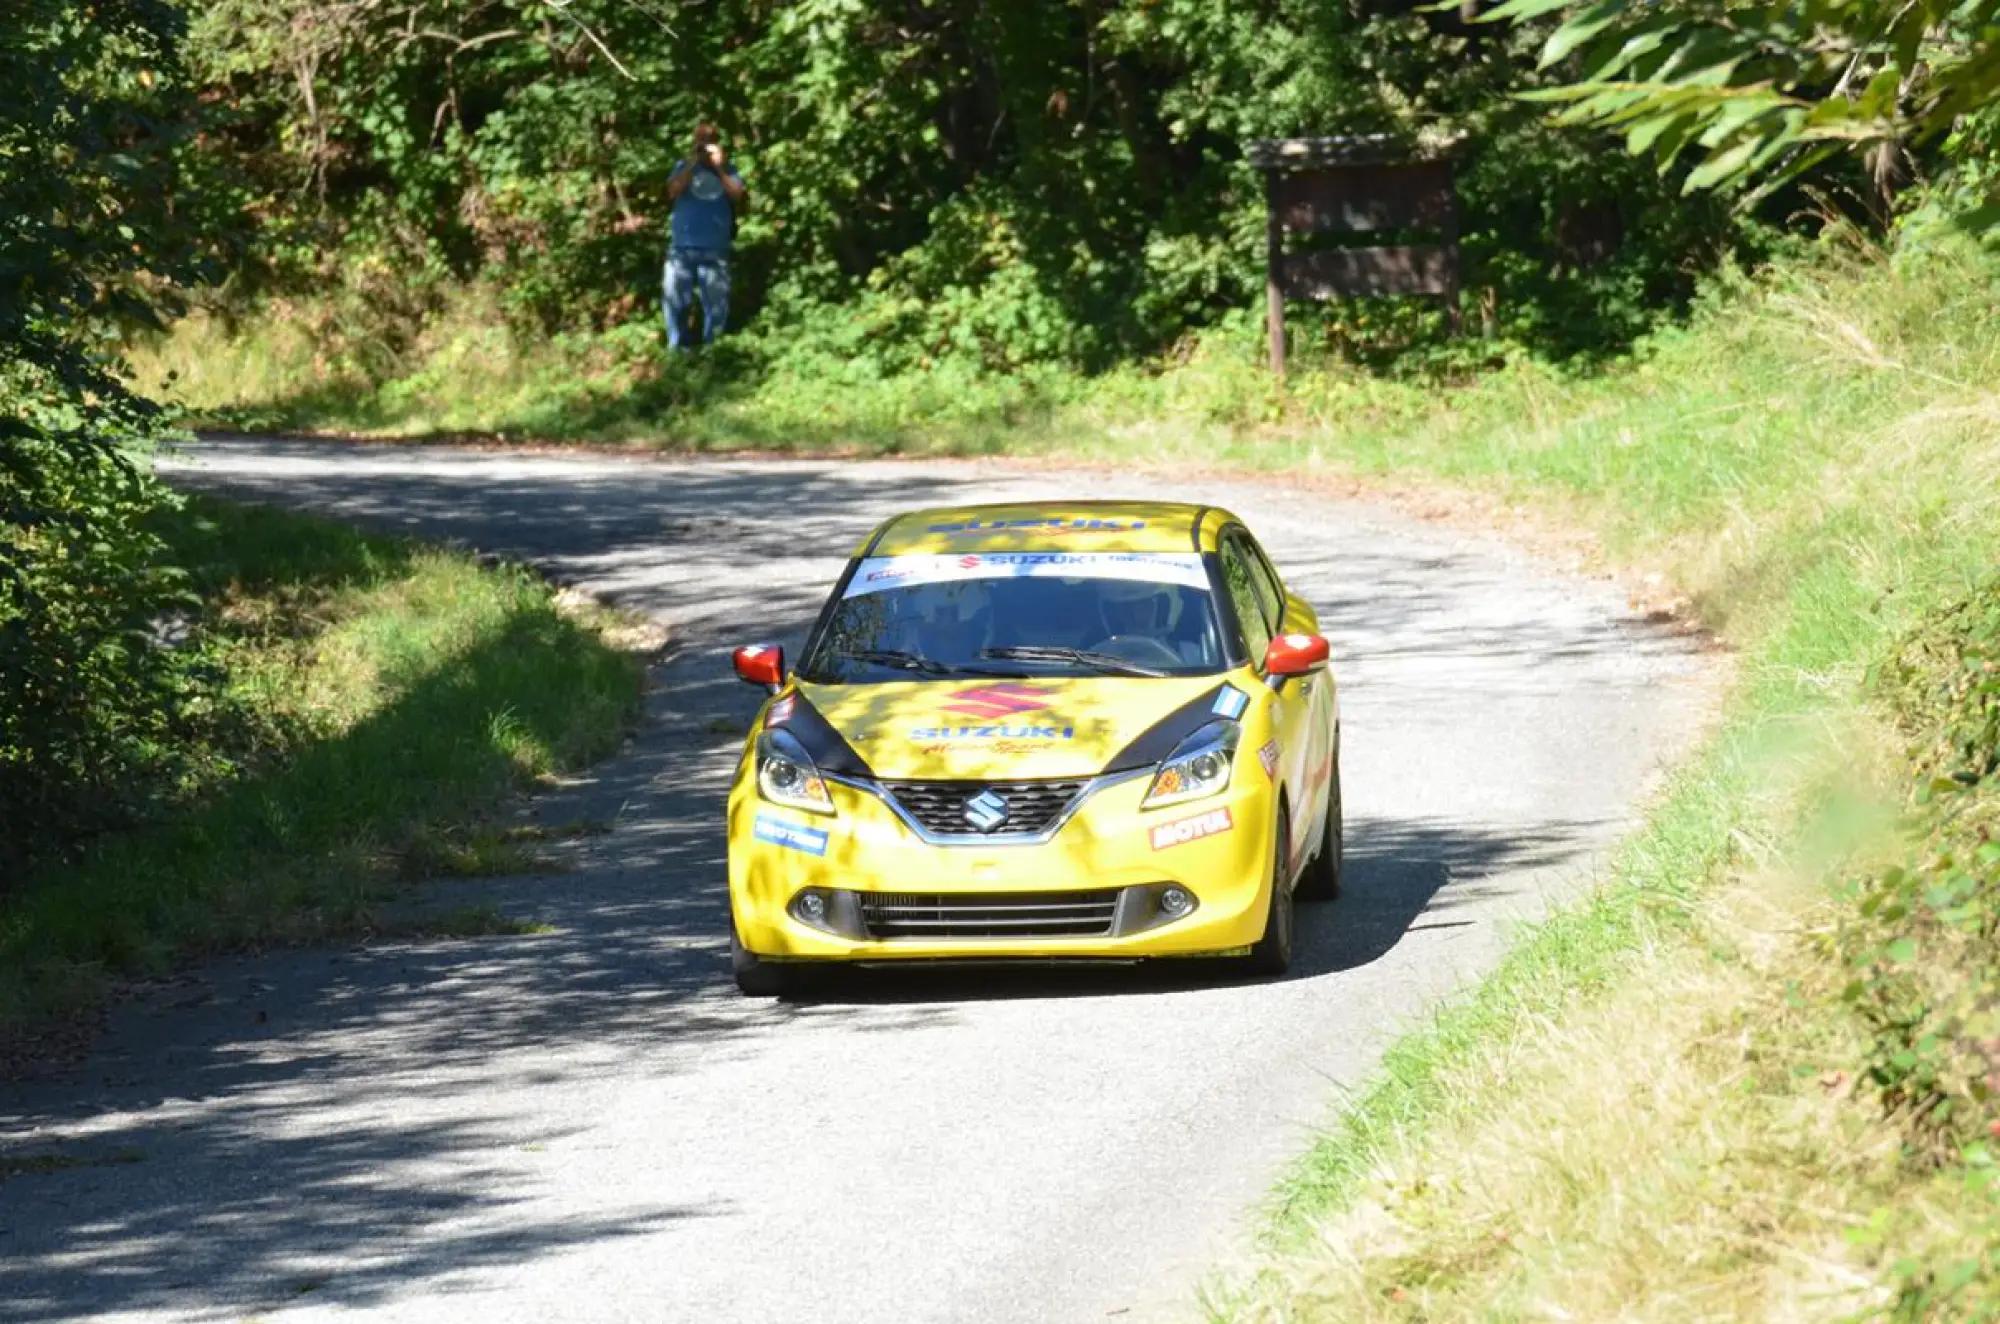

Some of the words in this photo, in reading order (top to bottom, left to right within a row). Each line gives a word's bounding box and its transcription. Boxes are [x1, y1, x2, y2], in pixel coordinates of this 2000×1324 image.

[988, 554, 1097, 566] SUZUKI
[910, 726, 1075, 739] SUZUKI
[1154, 808, 1230, 849] MOTUL
